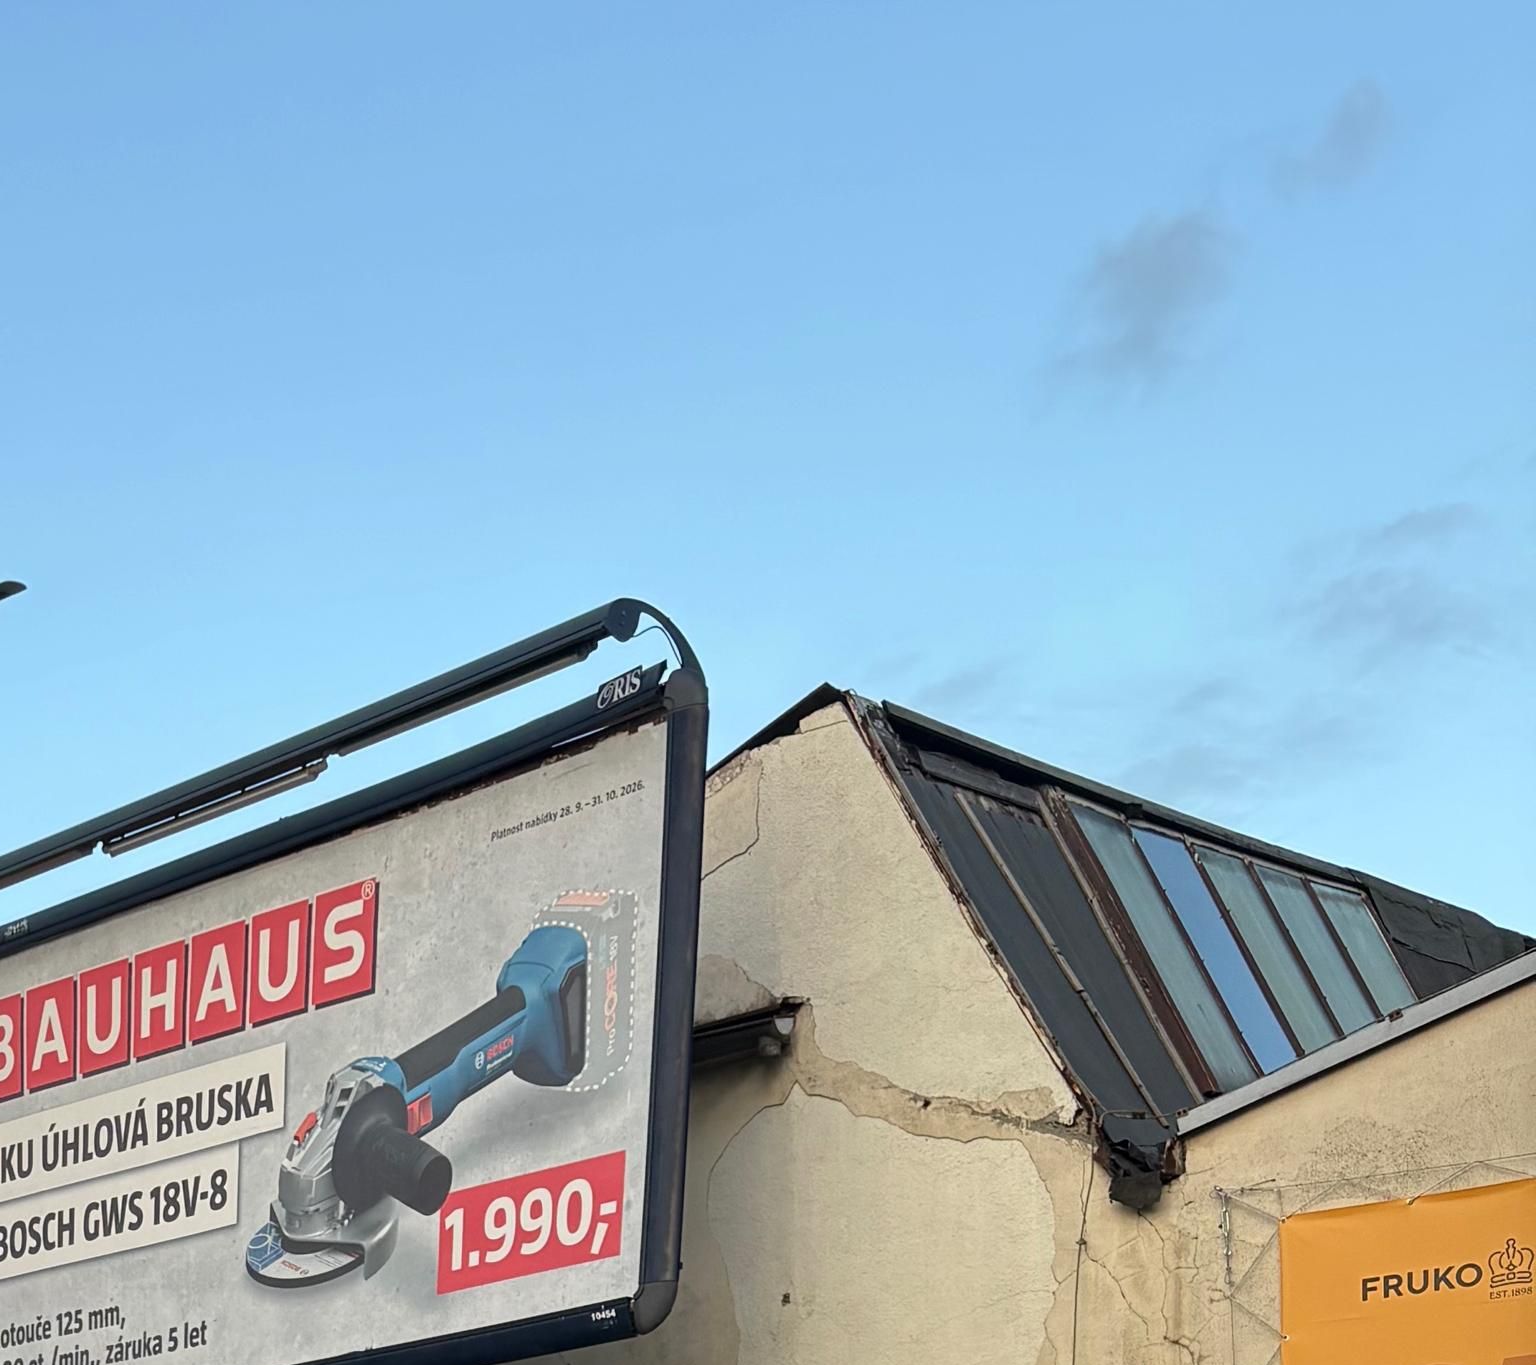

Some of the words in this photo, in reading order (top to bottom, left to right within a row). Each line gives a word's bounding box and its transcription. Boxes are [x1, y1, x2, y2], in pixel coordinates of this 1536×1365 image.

[597, 669, 642, 709] ORIS
[490, 821, 524, 842] Platnost
[525, 811, 558, 830] nabídky
[560, 805, 574, 818] 28.
[606, 789, 619, 802] 10.
[620, 780, 646, 797] 2026.
[41, 1097, 149, 1172] ÚHLOVÁ
[156, 1073, 275, 1143] BRUSKA
[83, 1191, 144, 1242] GWS
[149, 1169, 228, 1226] 18V-8
[1361, 1262, 1484, 1302] FRUKO
[56, 1309, 83, 1337] 125
[88, 1305, 126, 1330] mm,
[105, 1331, 163, 1365] záruka
[168, 1327, 179, 1352] 5
[184, 1320, 207, 1349] let
